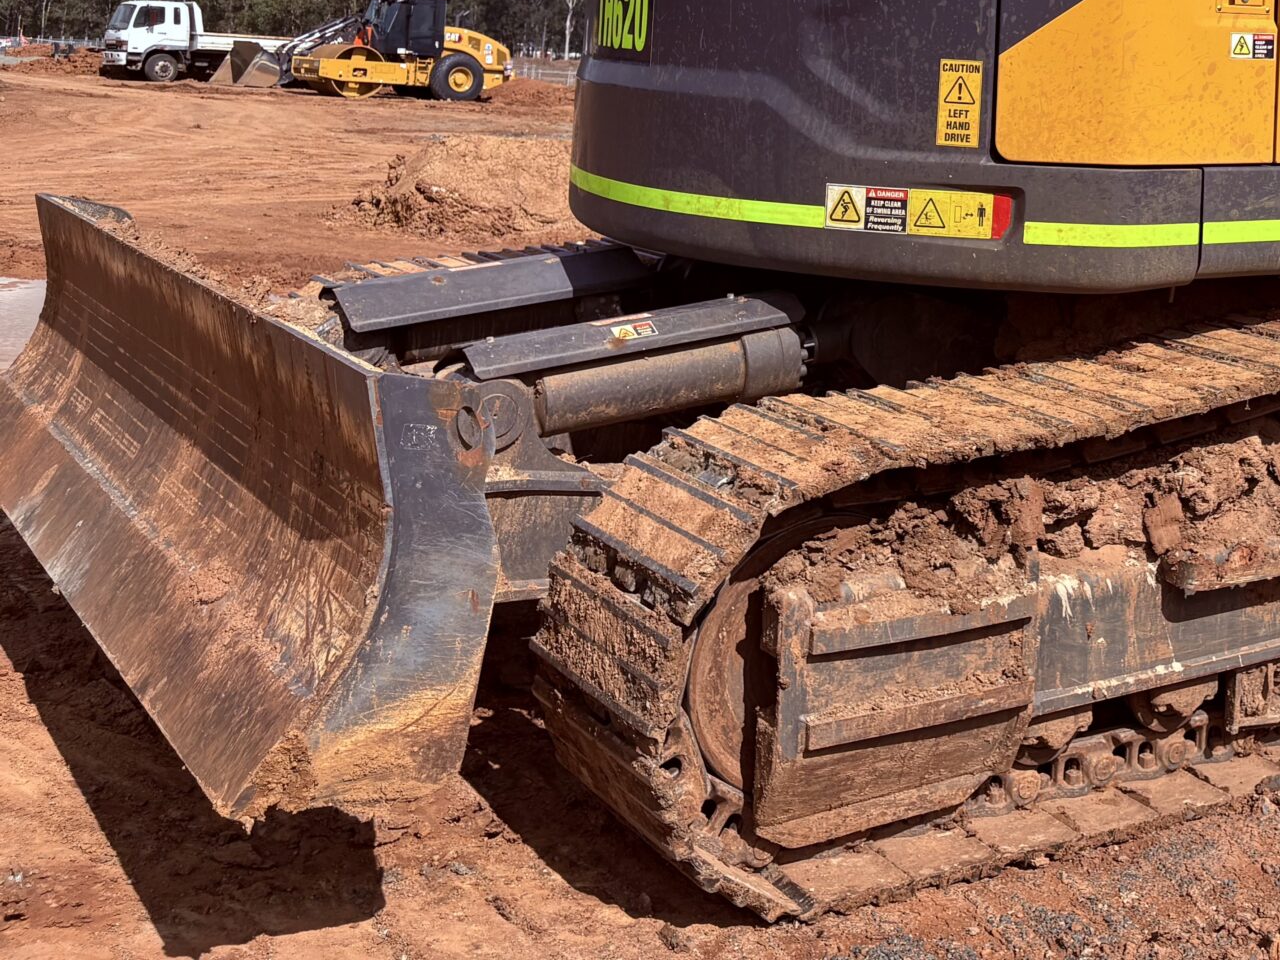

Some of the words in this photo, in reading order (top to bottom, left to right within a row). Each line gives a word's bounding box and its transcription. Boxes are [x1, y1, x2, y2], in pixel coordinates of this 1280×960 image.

[445, 32, 459, 42] CAT
[942, 63, 980, 74] CAUTION
[948, 109, 970, 118] LEFT
[946, 121, 970, 131] HAND
[944, 132, 971, 143] DRIVE
[869, 216, 901, 224] Reversing
[867, 222, 903, 231] Frequently
